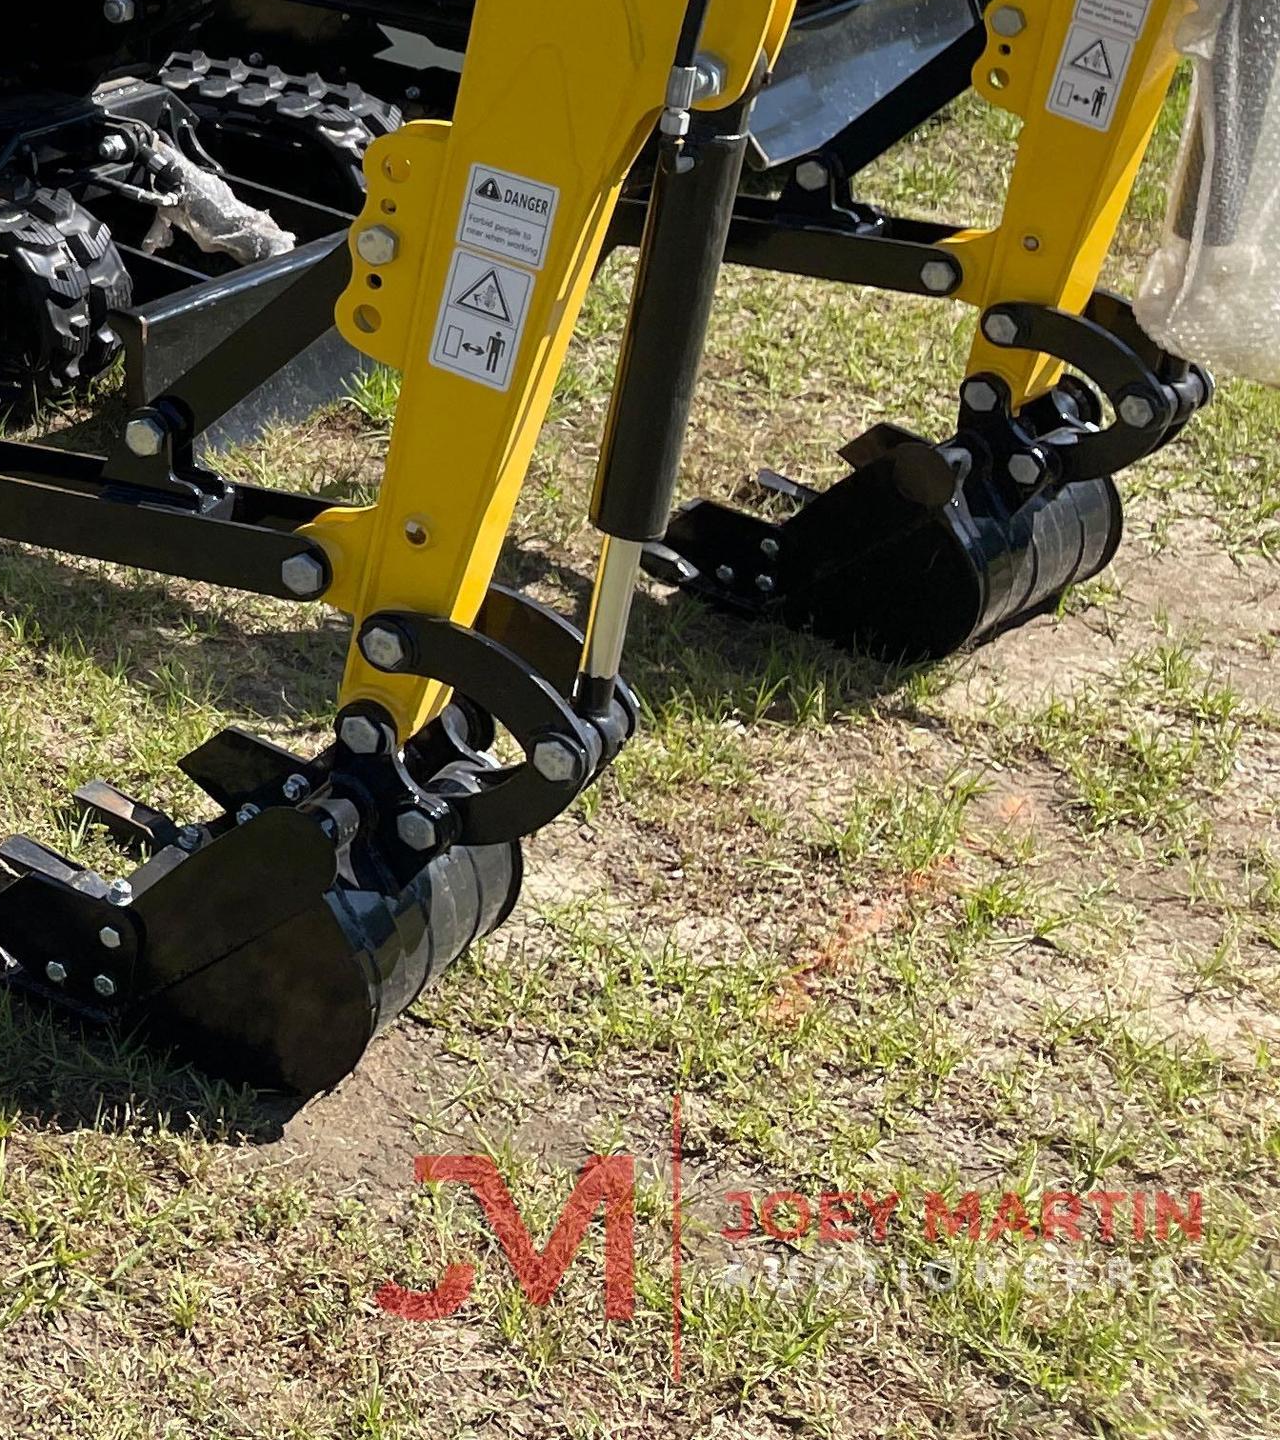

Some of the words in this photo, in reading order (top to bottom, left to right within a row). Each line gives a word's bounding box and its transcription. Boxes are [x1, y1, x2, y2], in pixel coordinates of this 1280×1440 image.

[504, 190, 548, 215] DANGER
[468, 213, 493, 229] Forbid
[494, 220, 521, 238] people
[522, 230, 532, 241] to
[486, 232, 505, 245] when
[507, 239, 538, 257] working
